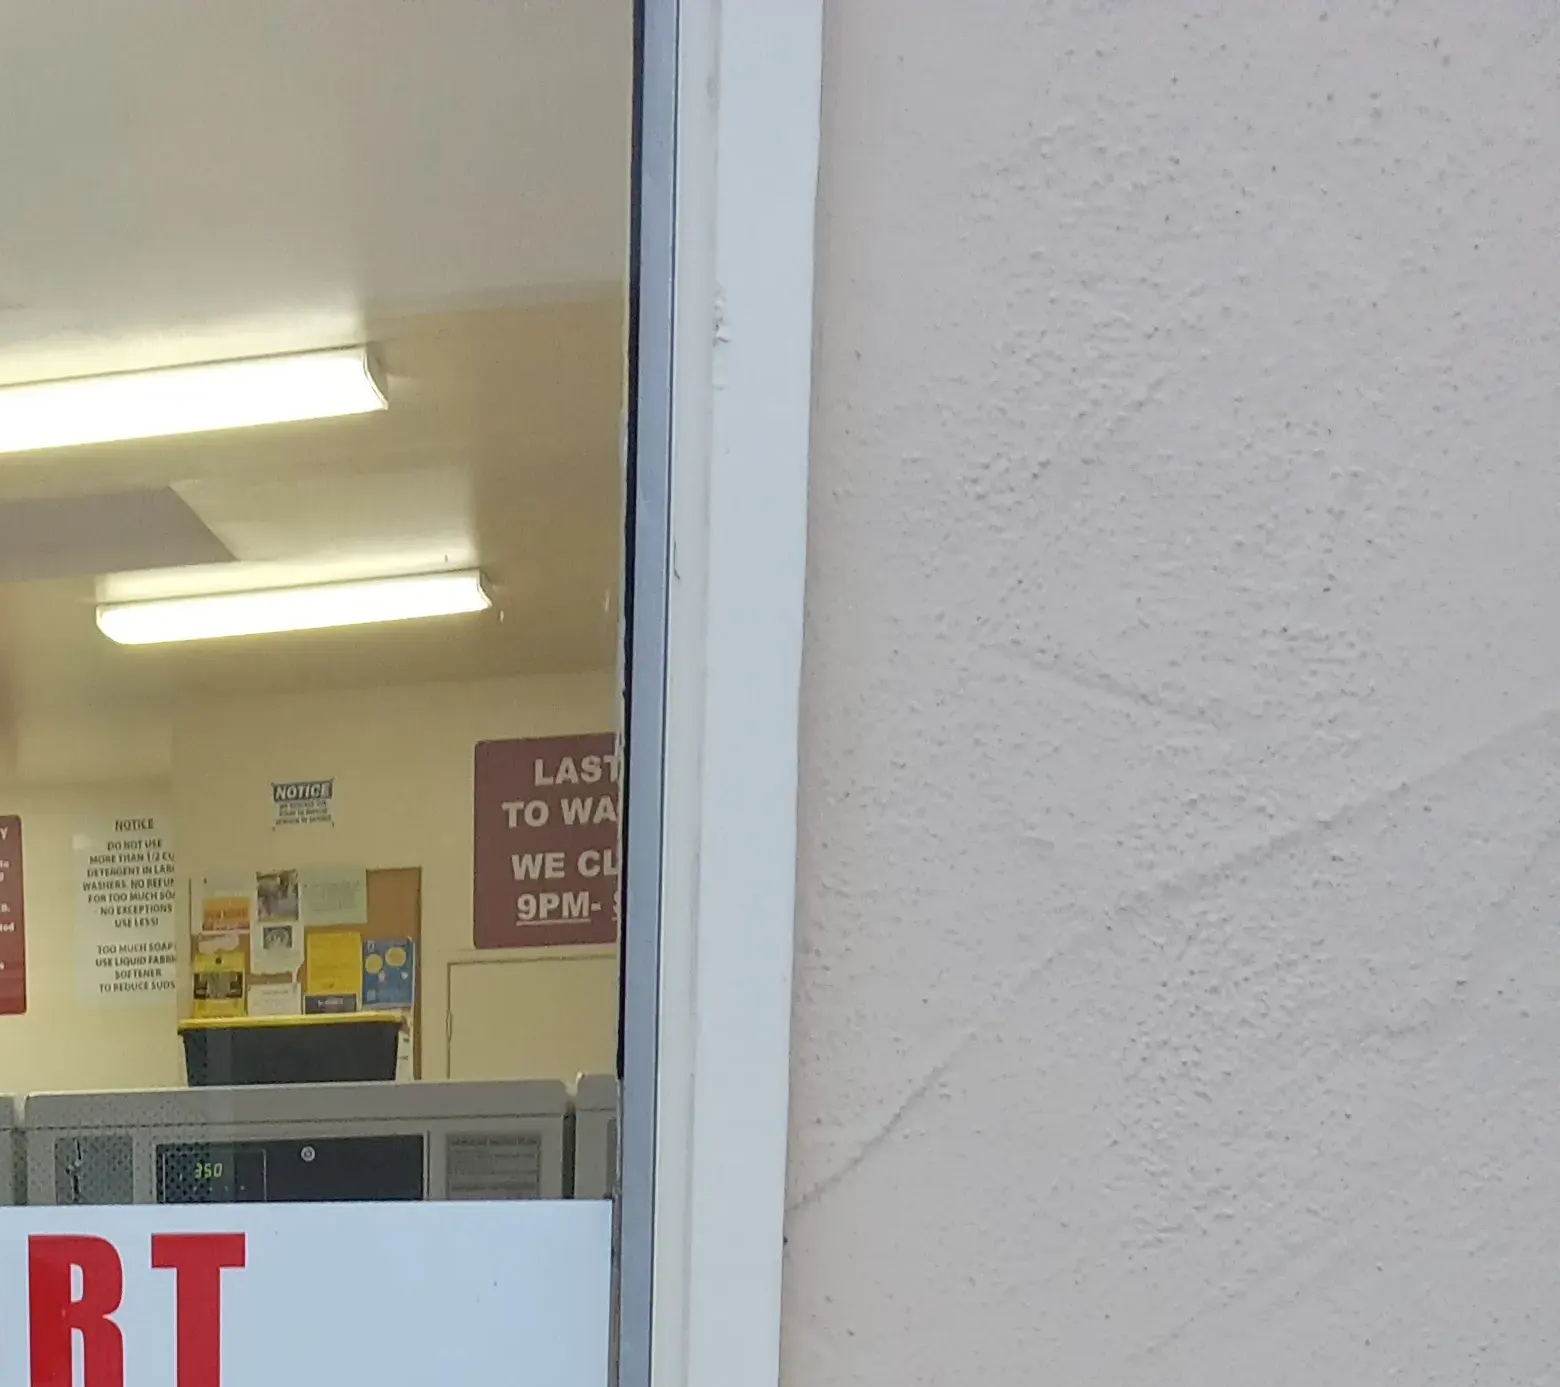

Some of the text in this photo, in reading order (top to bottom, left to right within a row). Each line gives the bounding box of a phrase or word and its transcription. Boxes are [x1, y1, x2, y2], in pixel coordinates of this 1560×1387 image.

[534, 754, 619, 786] LAST
[276, 783, 330, 800] NOTICE
[502, 796, 618, 828] TO WA
[115, 818, 154, 832] NOTICE
[107, 838, 161, 851] DO NOT USE
[90, 855, 116, 864] MORE
[119, 853, 144, 863] THAN
[87, 864, 174, 878] DETERGENT IN LAR
[512, 852, 565, 881] WE
[130, 879, 144, 888] NO
[88, 894, 106, 903] FOR
[108, 892, 127, 902] TOO
[130, 892, 158, 900] MUCH
[100, 906, 114, 915] NO
[114, 919, 132, 928] USE
[96, 942, 172, 954] TOO MUCH SOAP
[96, 958, 112, 967] USE
[114, 956, 146, 967] LIQUID
[115, 968, 162, 980] SOFTENER
[100, 983, 111, 992] TO
[114, 981, 148, 992] REDUCE
